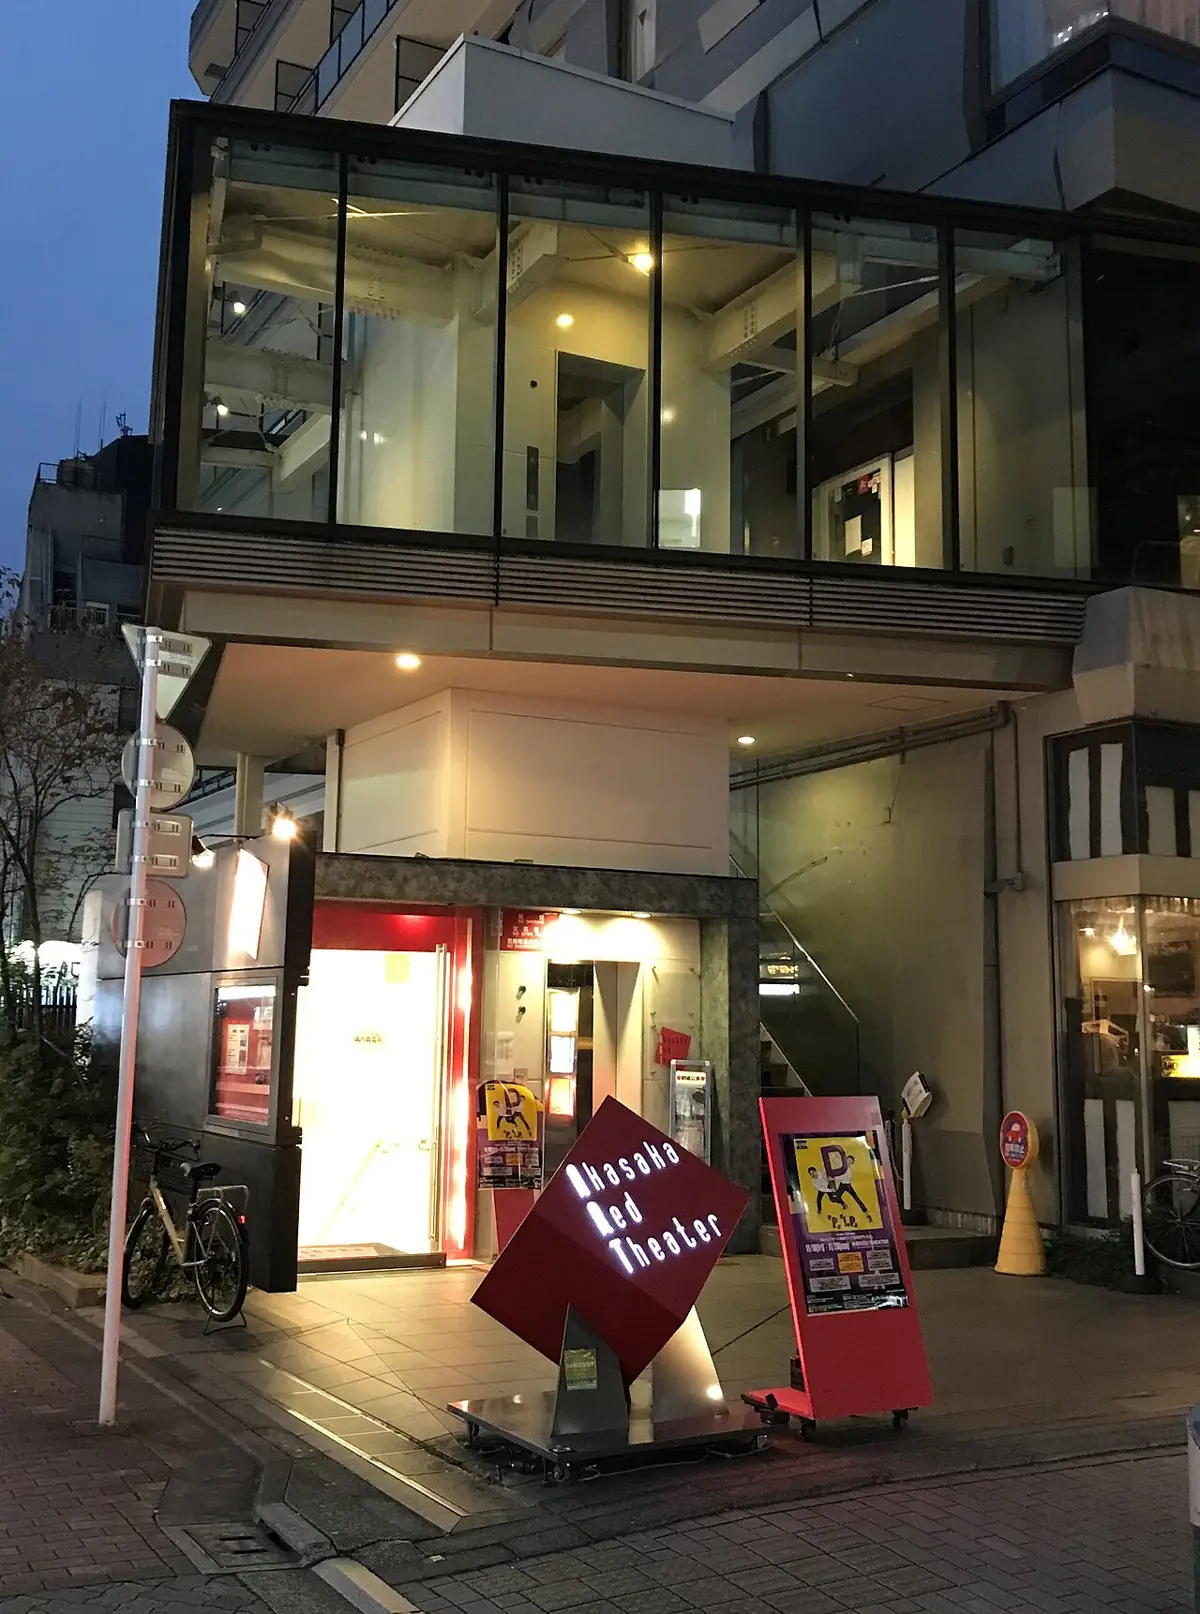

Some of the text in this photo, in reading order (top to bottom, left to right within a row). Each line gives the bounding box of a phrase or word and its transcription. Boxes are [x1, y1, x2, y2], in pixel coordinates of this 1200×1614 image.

[565, 1140, 680, 1198] Akasaka
[586, 1191, 643, 1236] Red
[608, 1213, 722, 1274] Theater
